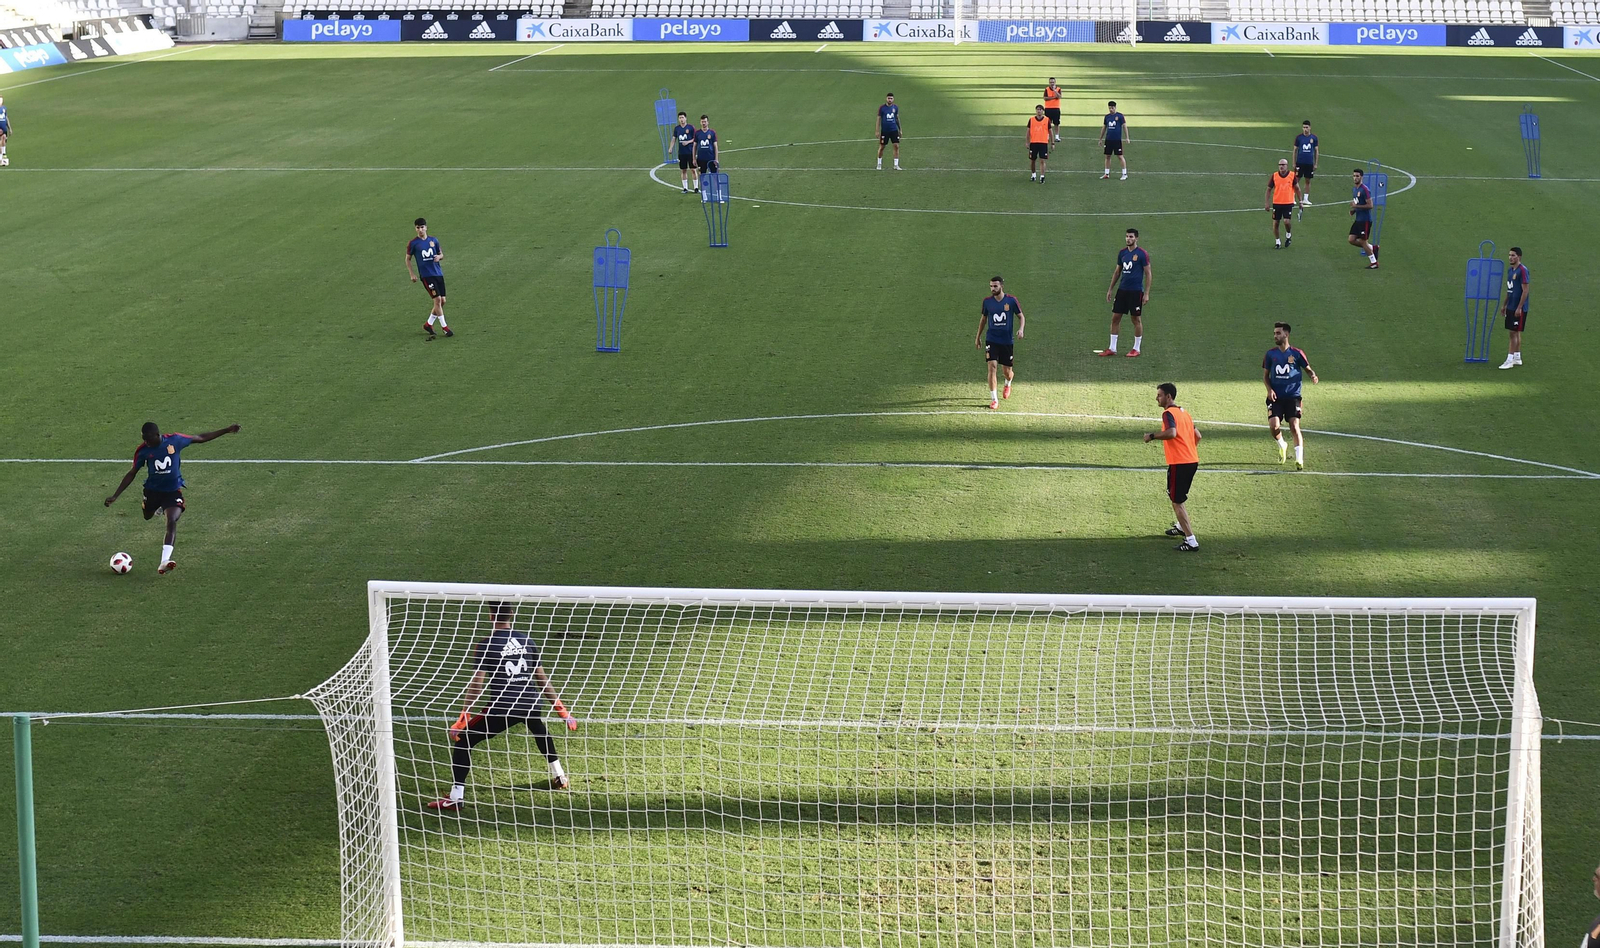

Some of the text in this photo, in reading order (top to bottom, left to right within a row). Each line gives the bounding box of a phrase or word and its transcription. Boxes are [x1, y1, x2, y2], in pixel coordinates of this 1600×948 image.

[311, 20, 373, 40] pelayo
[548, 22, 624, 38] CaixaBank
[660, 20, 722, 39] pelayo
[1006, 22, 1067, 42] pelayo
[1243, 24, 1320, 41] CaixaBank
[421, 31, 448, 40] adidas
[469, 30, 496, 39] adidas
[769, 30, 797, 39] adidas
[817, 30, 845, 39] adidas
[1163, 34, 1191, 42] adidas
[1356, 24, 1419, 45] pelayo
[1467, 38, 1495, 46] adidas
[1515, 38, 1543, 46] adidas
[501, 648, 528, 656] adidas
